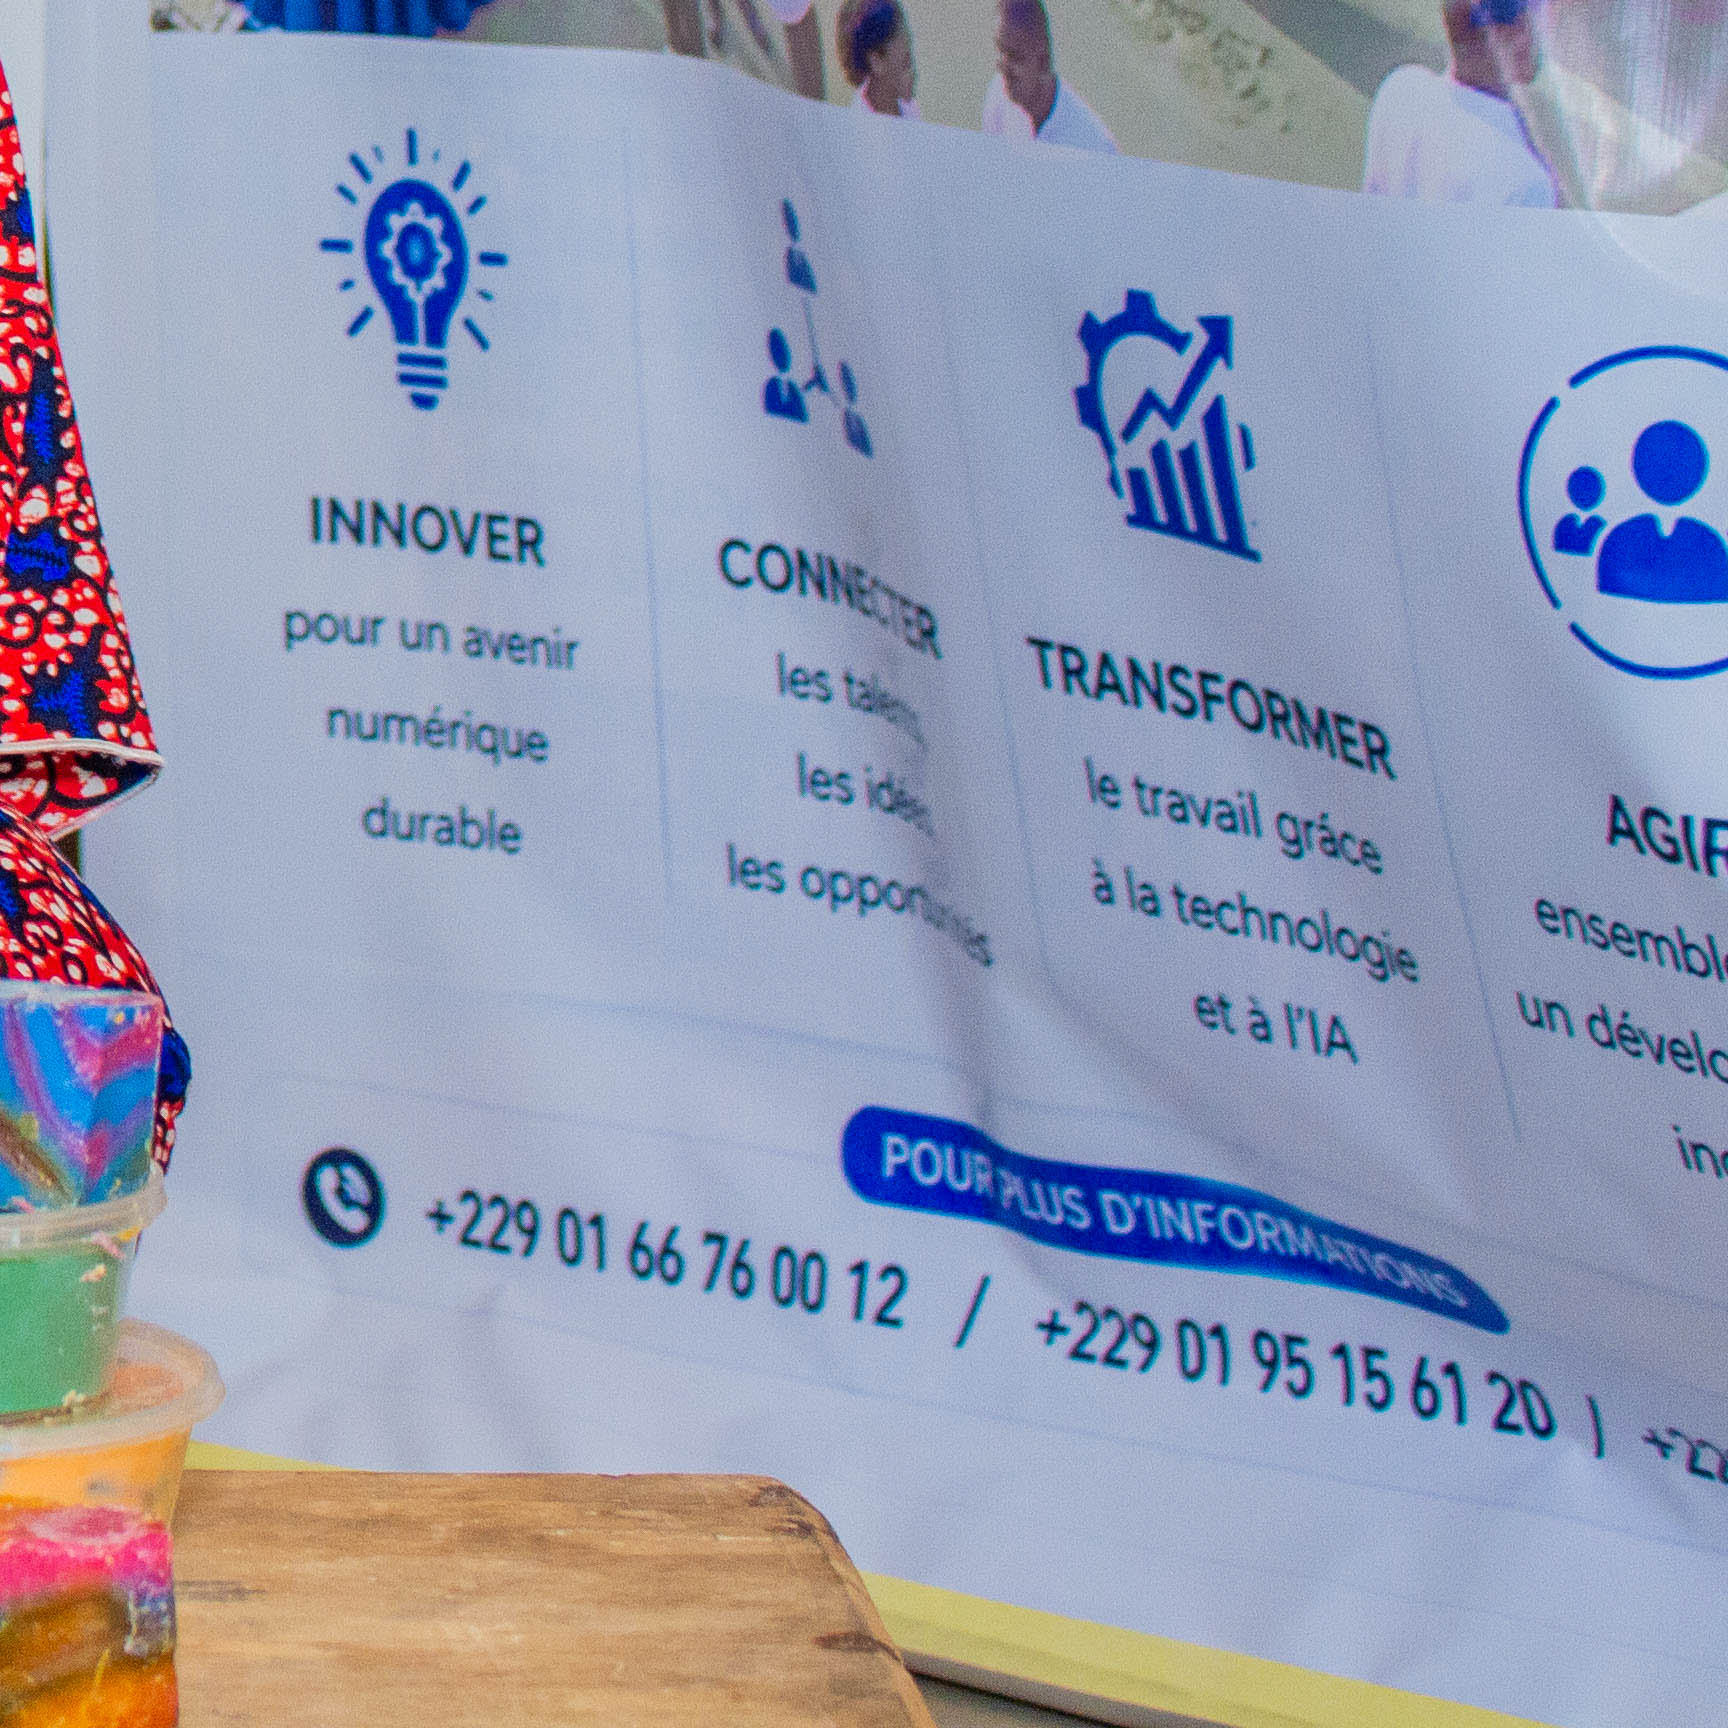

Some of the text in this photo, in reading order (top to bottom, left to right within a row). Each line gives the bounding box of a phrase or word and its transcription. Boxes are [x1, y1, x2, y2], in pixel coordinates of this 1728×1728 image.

[308, 495, 547, 569] INNOVER
[283, 607, 580, 671] pour un avenir
[776, 650, 834, 704] les
[1026, 634, 1398, 781] TRANSFORMER
[326, 702, 551, 769] numérique
[797, 751, 855, 807] les
[1084, 755, 1123, 810] le
[1130, 772, 1263, 839] travail
[361, 797, 524, 856] durable
[726, 840, 787, 895] les
[1092, 856, 1422, 983] à la technologie
[1532, 897, 1728, 984] ensembl
[1192, 989, 1236, 1032] et
[1247, 995, 1274, 1045] à
[1513, 990, 1576, 1039] un
[881, 1133, 995, 1200] POUR
[425, 1188, 540, 1259] +229
[555, 1207, 608, 1273] 01
[627, 1220, 686, 1286] 66
[701, 1230, 757, 1301] 76
[770, 1245, 829, 1315] 00
[847, 1258, 910, 1329] 12
[1036, 1298, 1162, 1374] +229
[1176, 1317, 1234, 1387] 01
[1253, 1328, 1316, 1400] 95
[1330, 1340, 1395, 1414] 15
[1410, 1354, 1469, 1427] 61
[1485, 1367, 1558, 1441] 20
